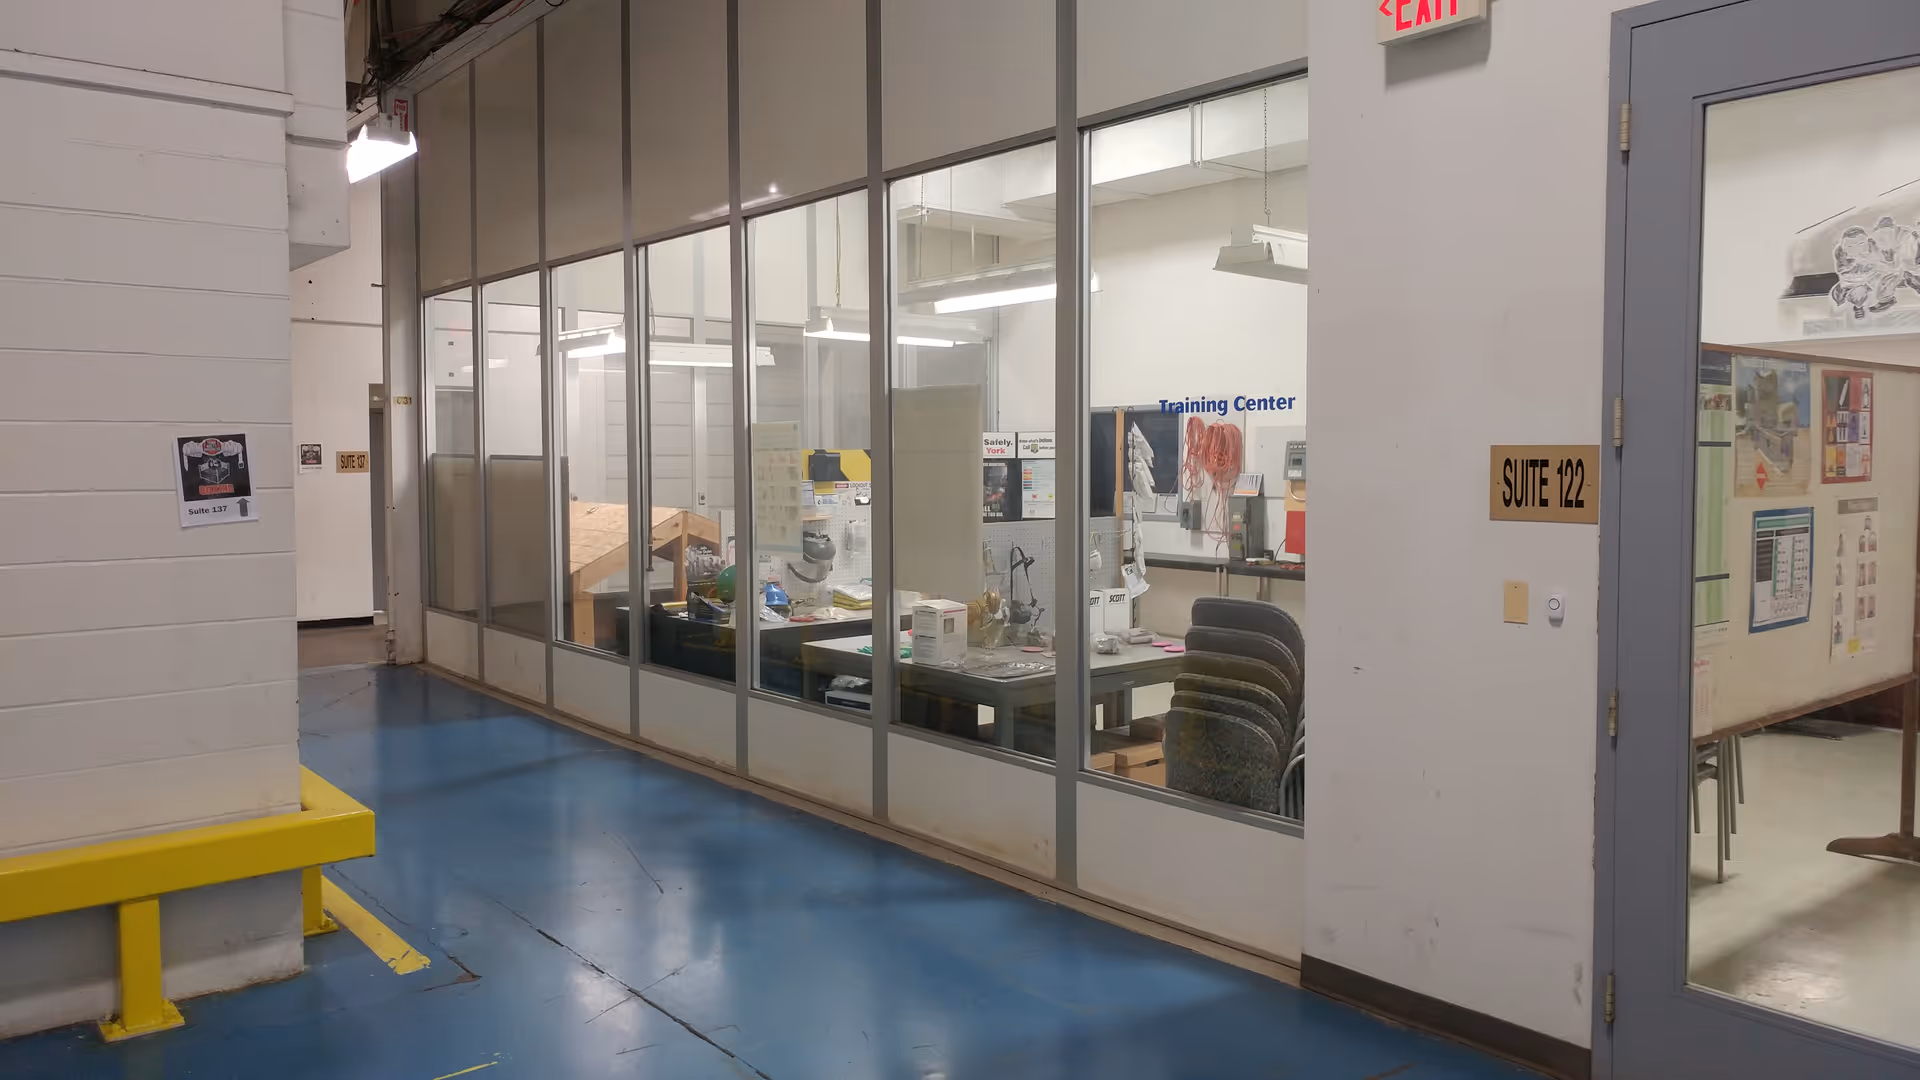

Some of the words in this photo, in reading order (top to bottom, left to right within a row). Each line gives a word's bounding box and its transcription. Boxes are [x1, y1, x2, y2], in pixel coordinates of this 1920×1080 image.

[1159, 396, 1228, 416] Training
[1233, 395, 1296, 412] Center
[984, 439, 1013, 447] Safely.
[340, 454, 355, 469] SUITE
[357, 454, 366, 468] 137
[1502, 457, 1549, 508] SUITE
[1556, 458, 1585, 509] 122
[188, 507, 210, 516] Suite
[212, 505, 228, 513] 137
[1090, 596, 1100, 606] OTT
[1109, 593, 1126, 603] SCOTT
